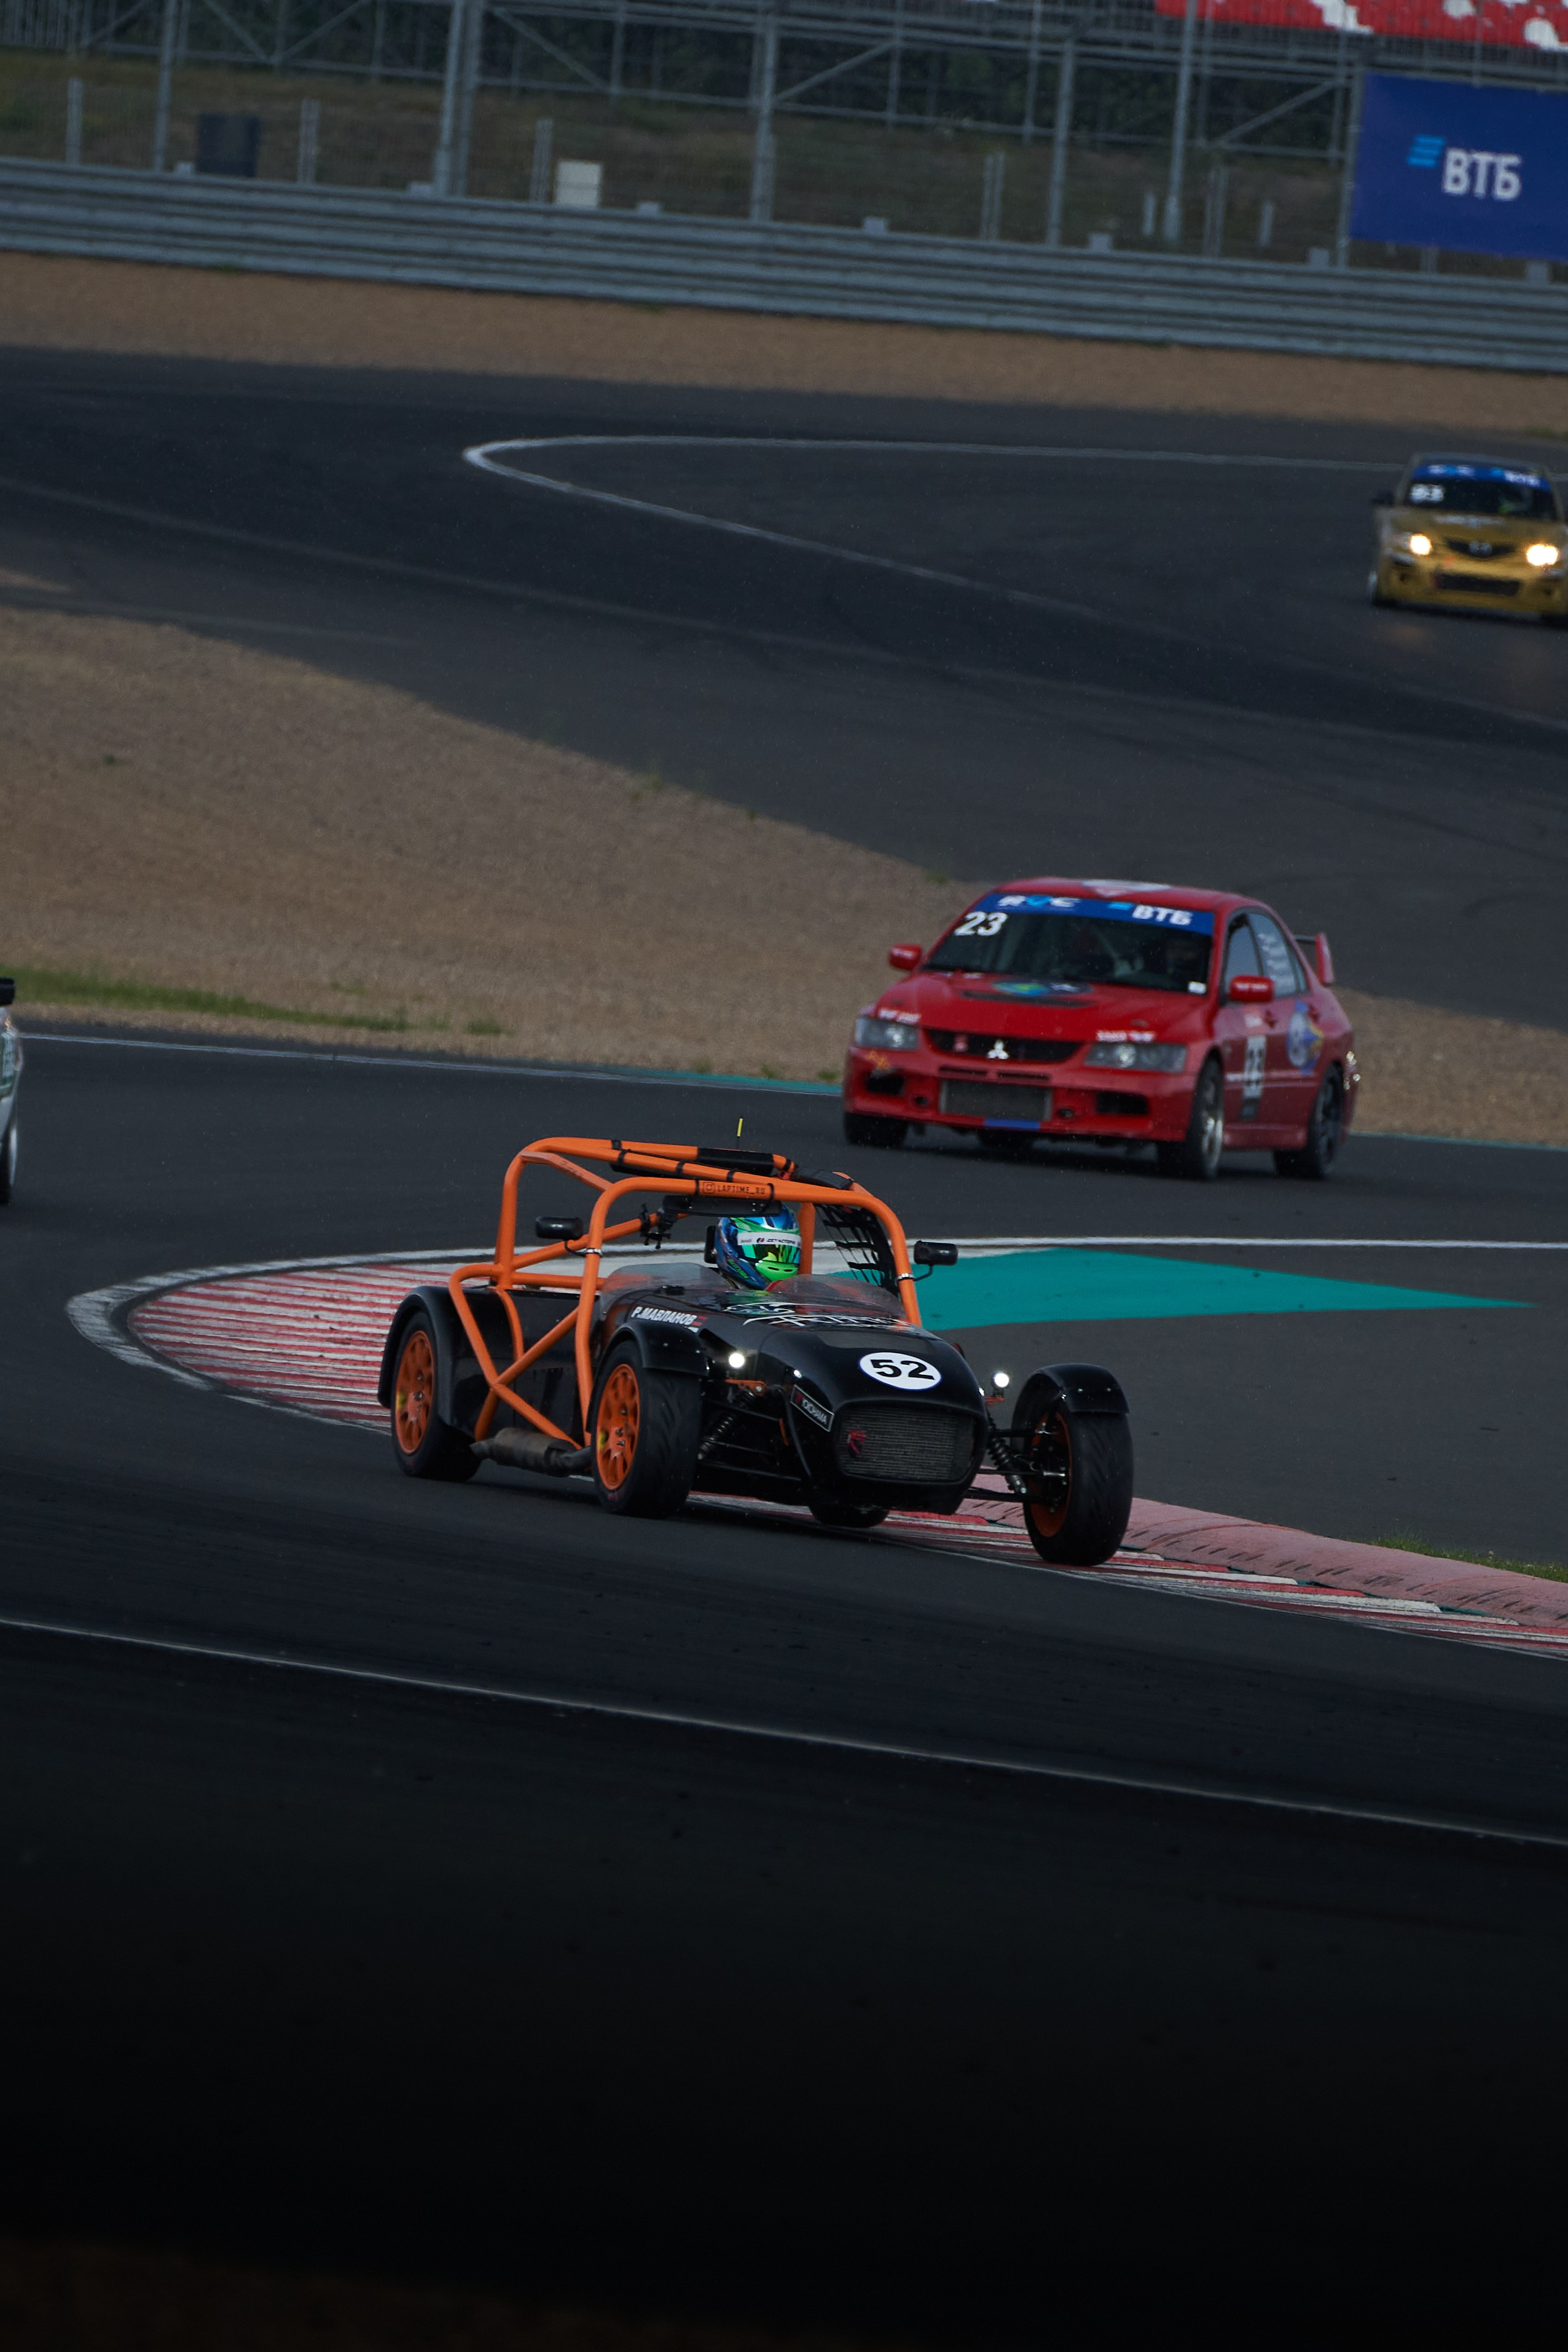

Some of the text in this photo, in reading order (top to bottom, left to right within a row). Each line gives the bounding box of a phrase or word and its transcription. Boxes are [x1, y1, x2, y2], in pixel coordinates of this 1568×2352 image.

[1443, 147, 1523, 201] ВТБ
[954, 911, 1009, 936] 23
[1132, 904, 1193, 926] ВТБ
[870, 1359, 935, 1380] 52
